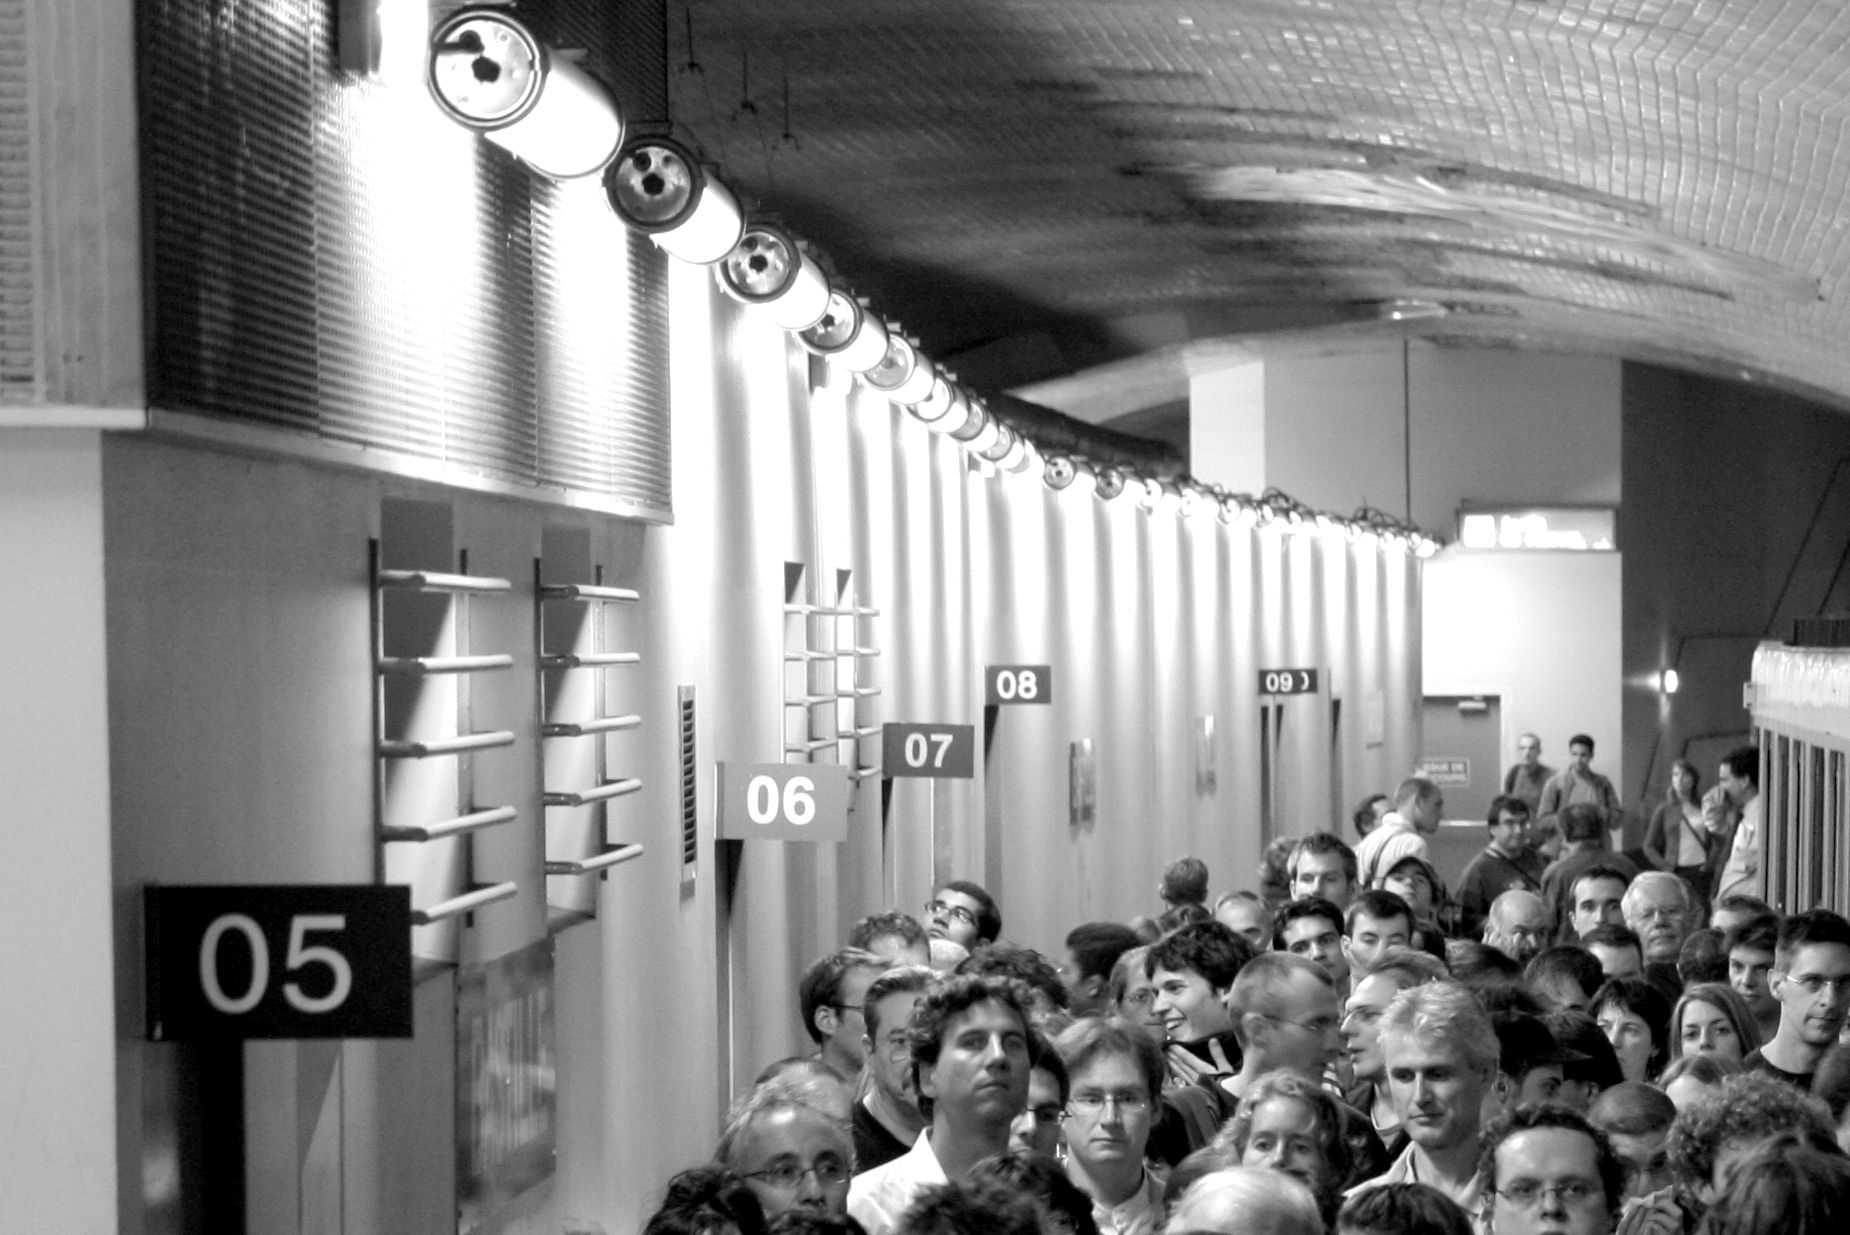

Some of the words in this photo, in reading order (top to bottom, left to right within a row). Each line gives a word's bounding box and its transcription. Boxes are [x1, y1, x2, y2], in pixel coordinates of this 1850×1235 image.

[996, 670, 1037, 699] 08
[1265, 672, 1293, 692] 09
[904, 733, 953, 768] 07
[747, 775, 816, 825] 06
[200, 912, 352, 1014] 05
